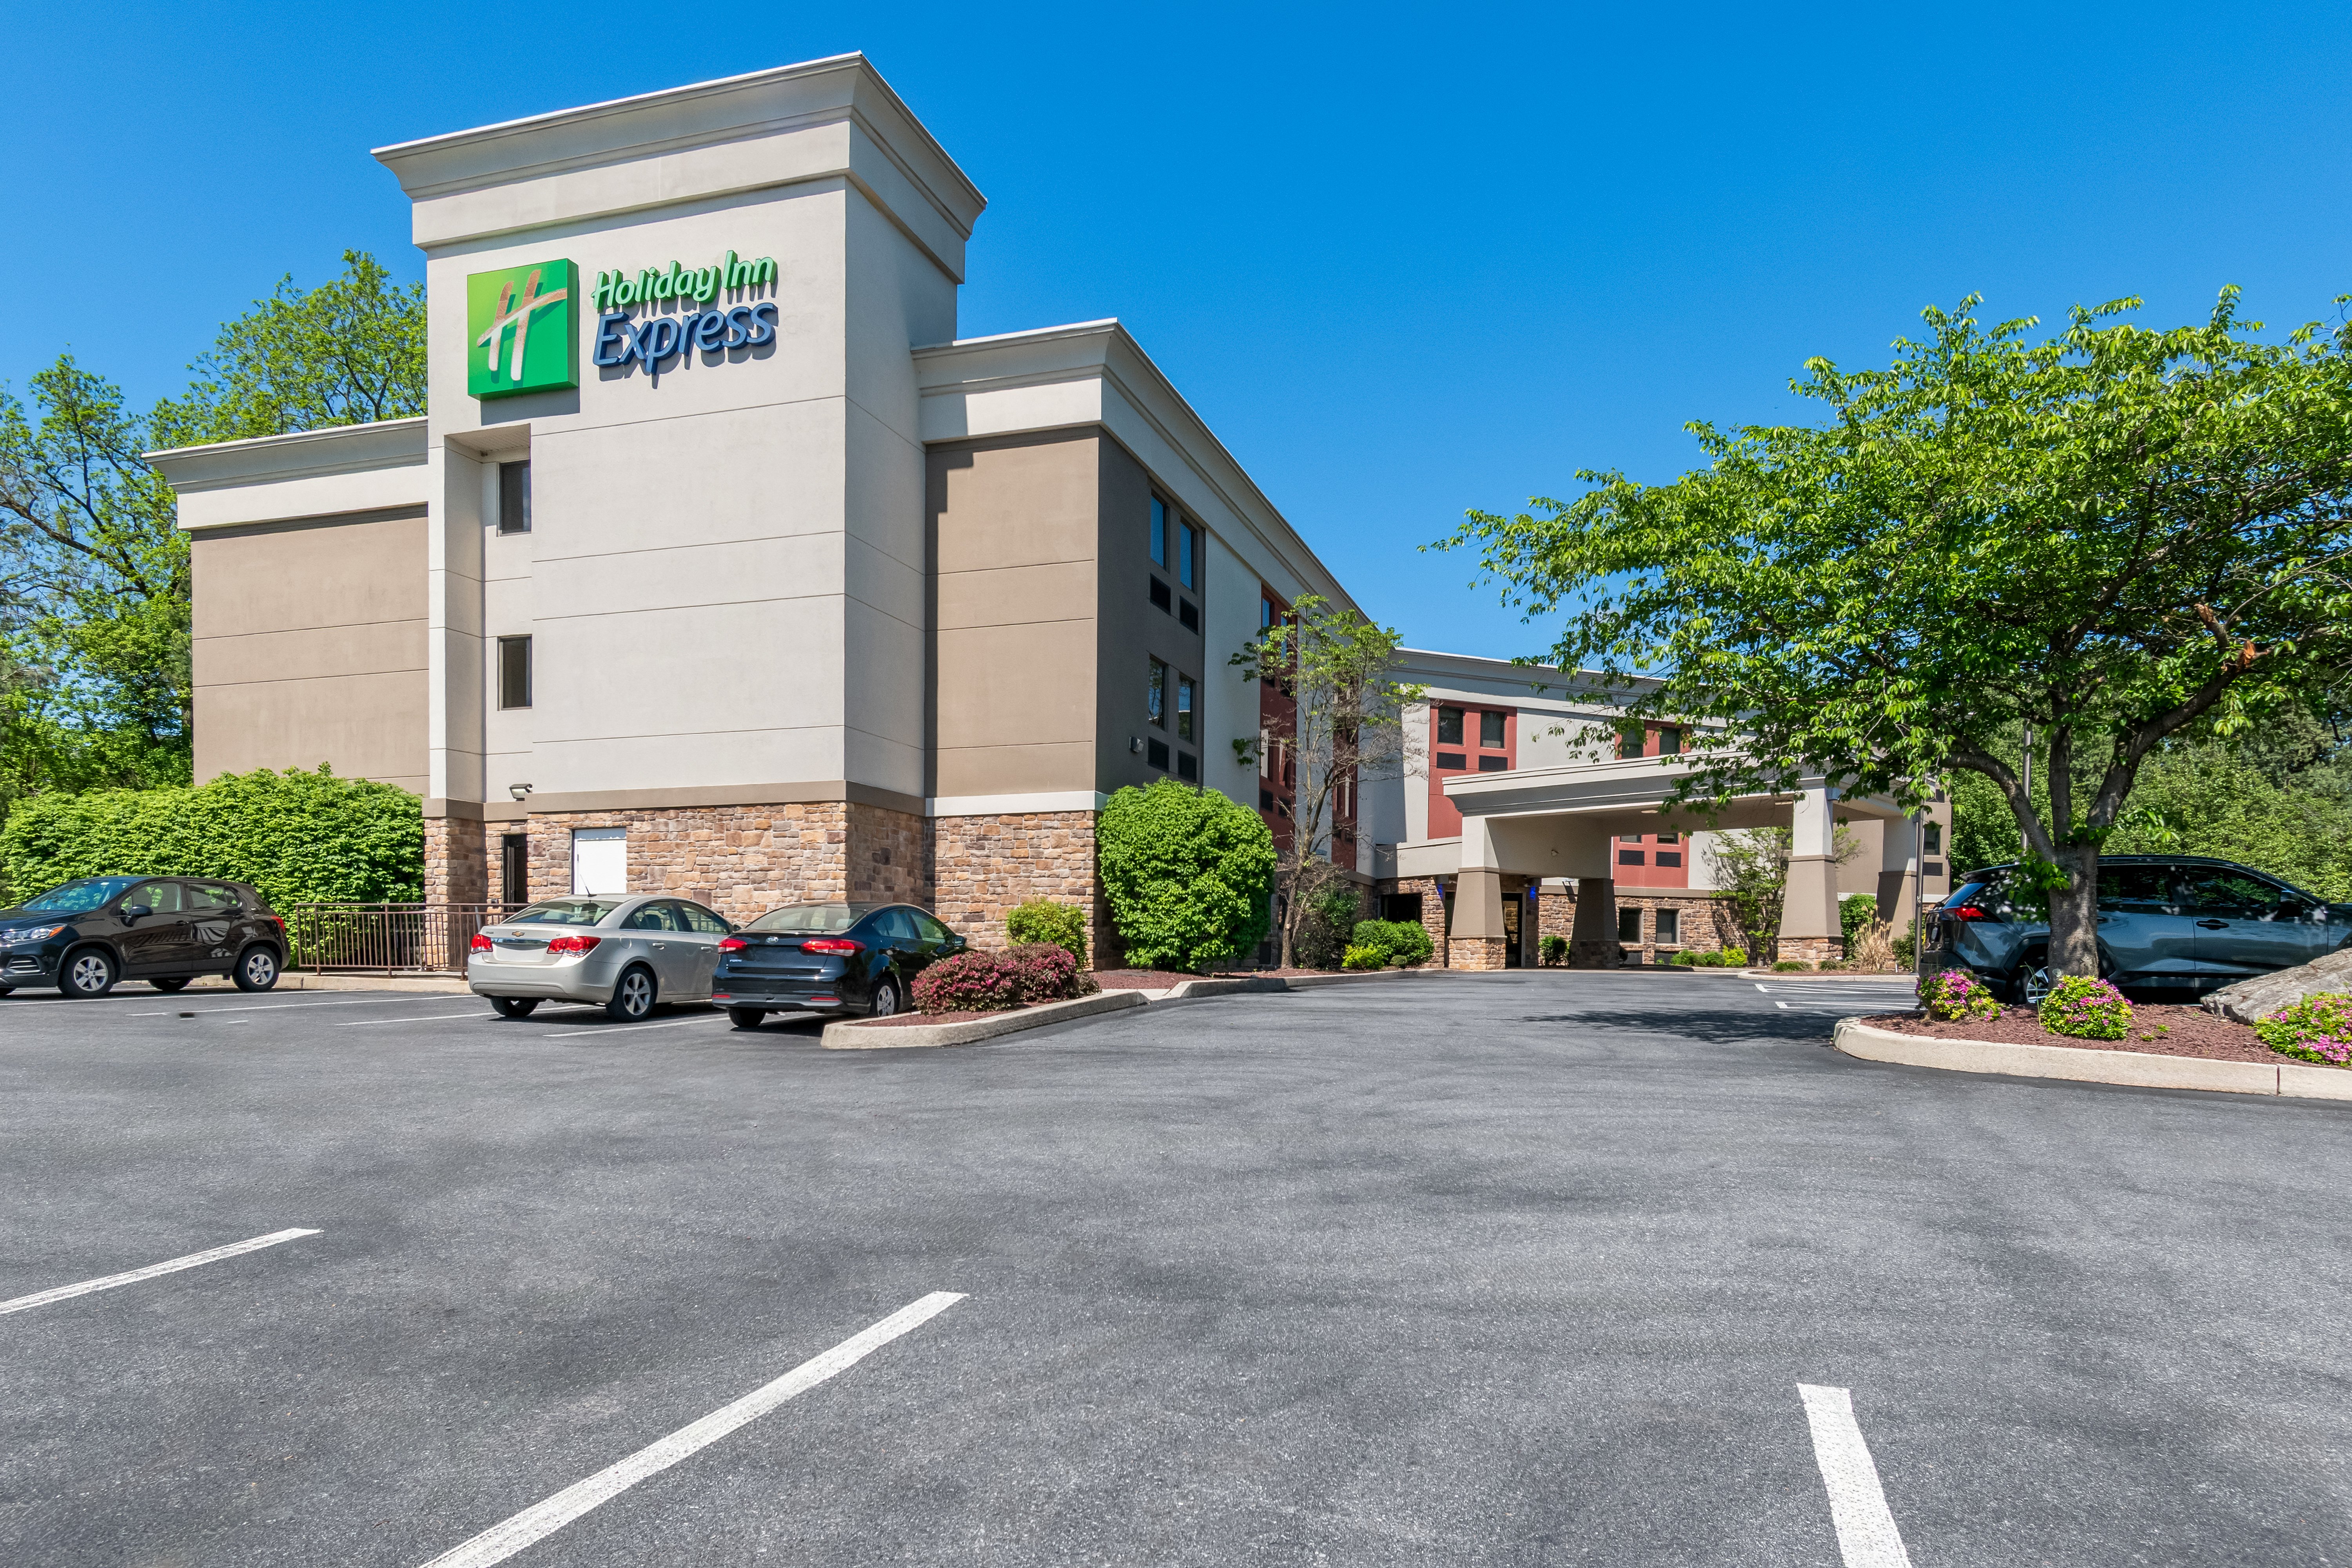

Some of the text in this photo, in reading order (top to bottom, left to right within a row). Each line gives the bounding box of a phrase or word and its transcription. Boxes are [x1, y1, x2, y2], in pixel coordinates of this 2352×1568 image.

[591, 250, 778, 310] Holiday Inn
[593, 302, 778, 375] Express
